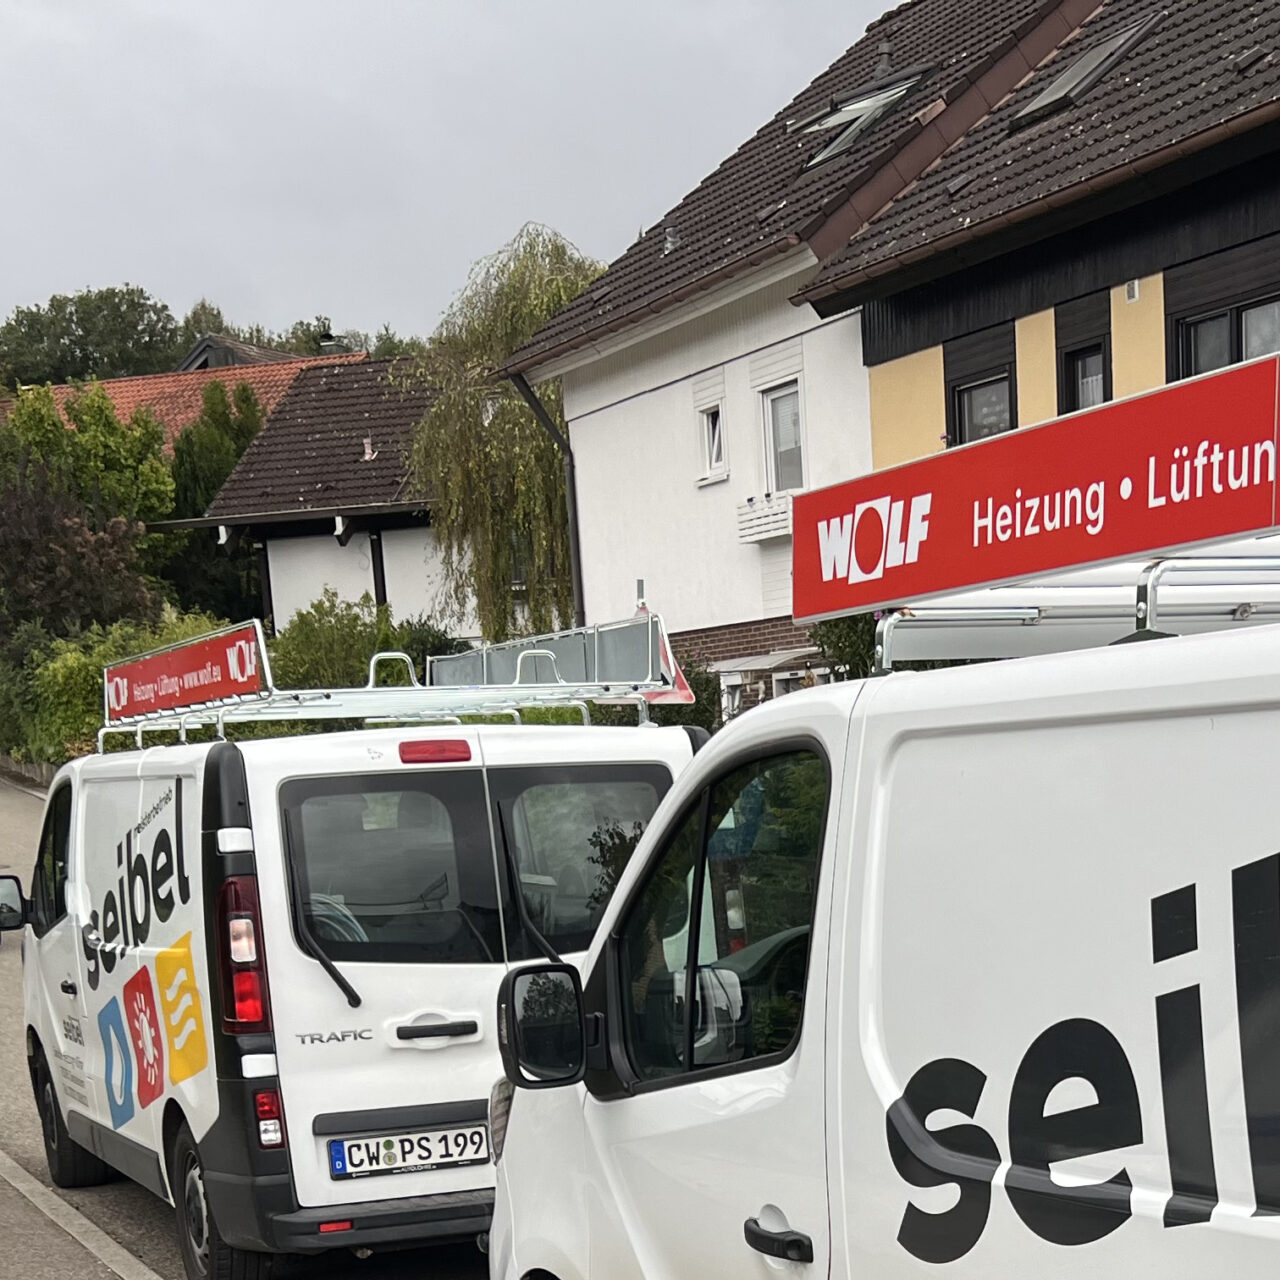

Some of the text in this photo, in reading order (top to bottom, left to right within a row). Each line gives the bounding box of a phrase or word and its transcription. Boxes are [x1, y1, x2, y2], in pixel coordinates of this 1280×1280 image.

[817, 493, 931, 585] WOLF
[973, 481, 1105, 547] Heizung
[82, 775, 190, 991] seibel
[295, 1028, 374, 1045] TRAFIC
[335, 1160, 343, 1169] D
[347, 1130, 484, 1168] CW PS 199
